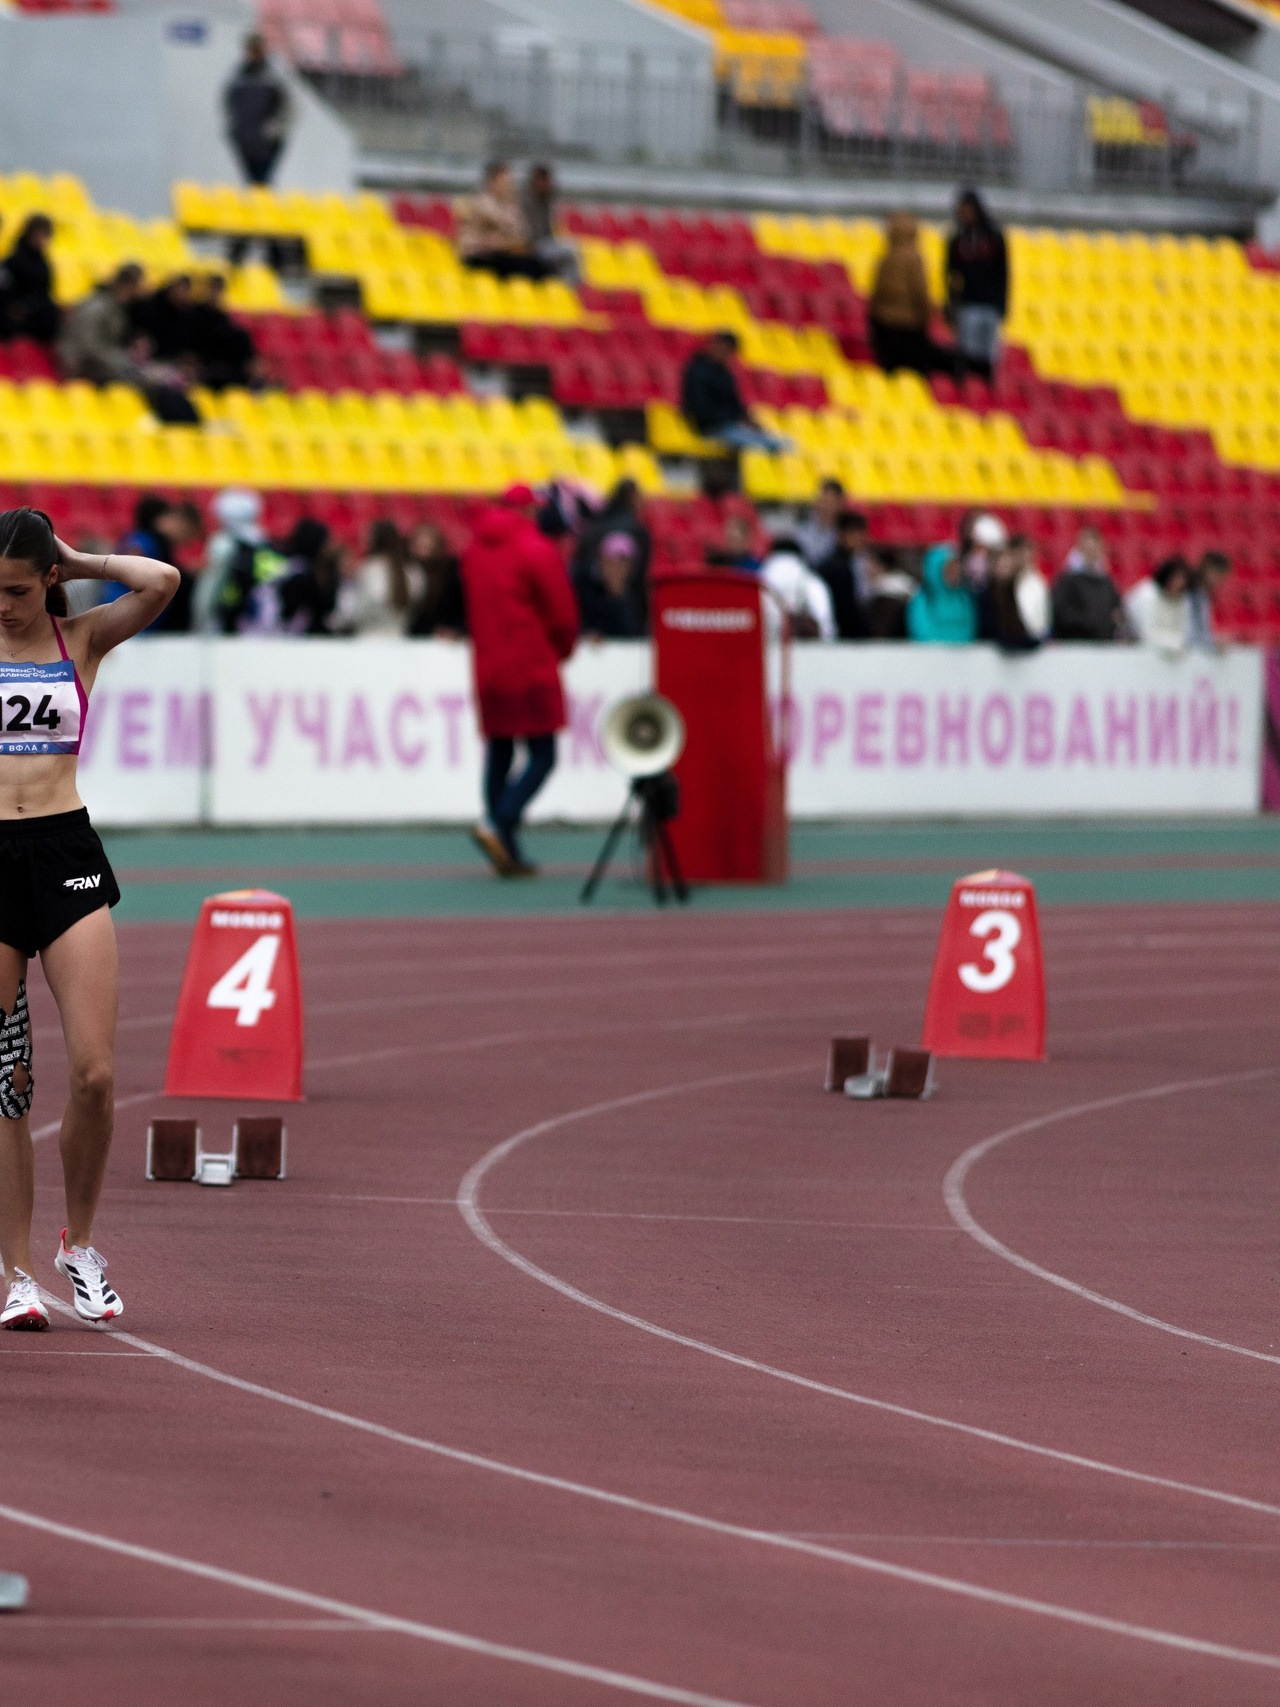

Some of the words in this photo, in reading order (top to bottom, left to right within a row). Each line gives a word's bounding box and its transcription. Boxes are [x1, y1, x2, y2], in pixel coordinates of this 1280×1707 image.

[245, 690, 607, 768] УЧАСТК
[764, 676, 1239, 768] ОРЕВНОВАНИЙ!
[63, 874, 101, 890] RAY
[207, 934, 281, 1027] 4
[958, 910, 1021, 993] 3
